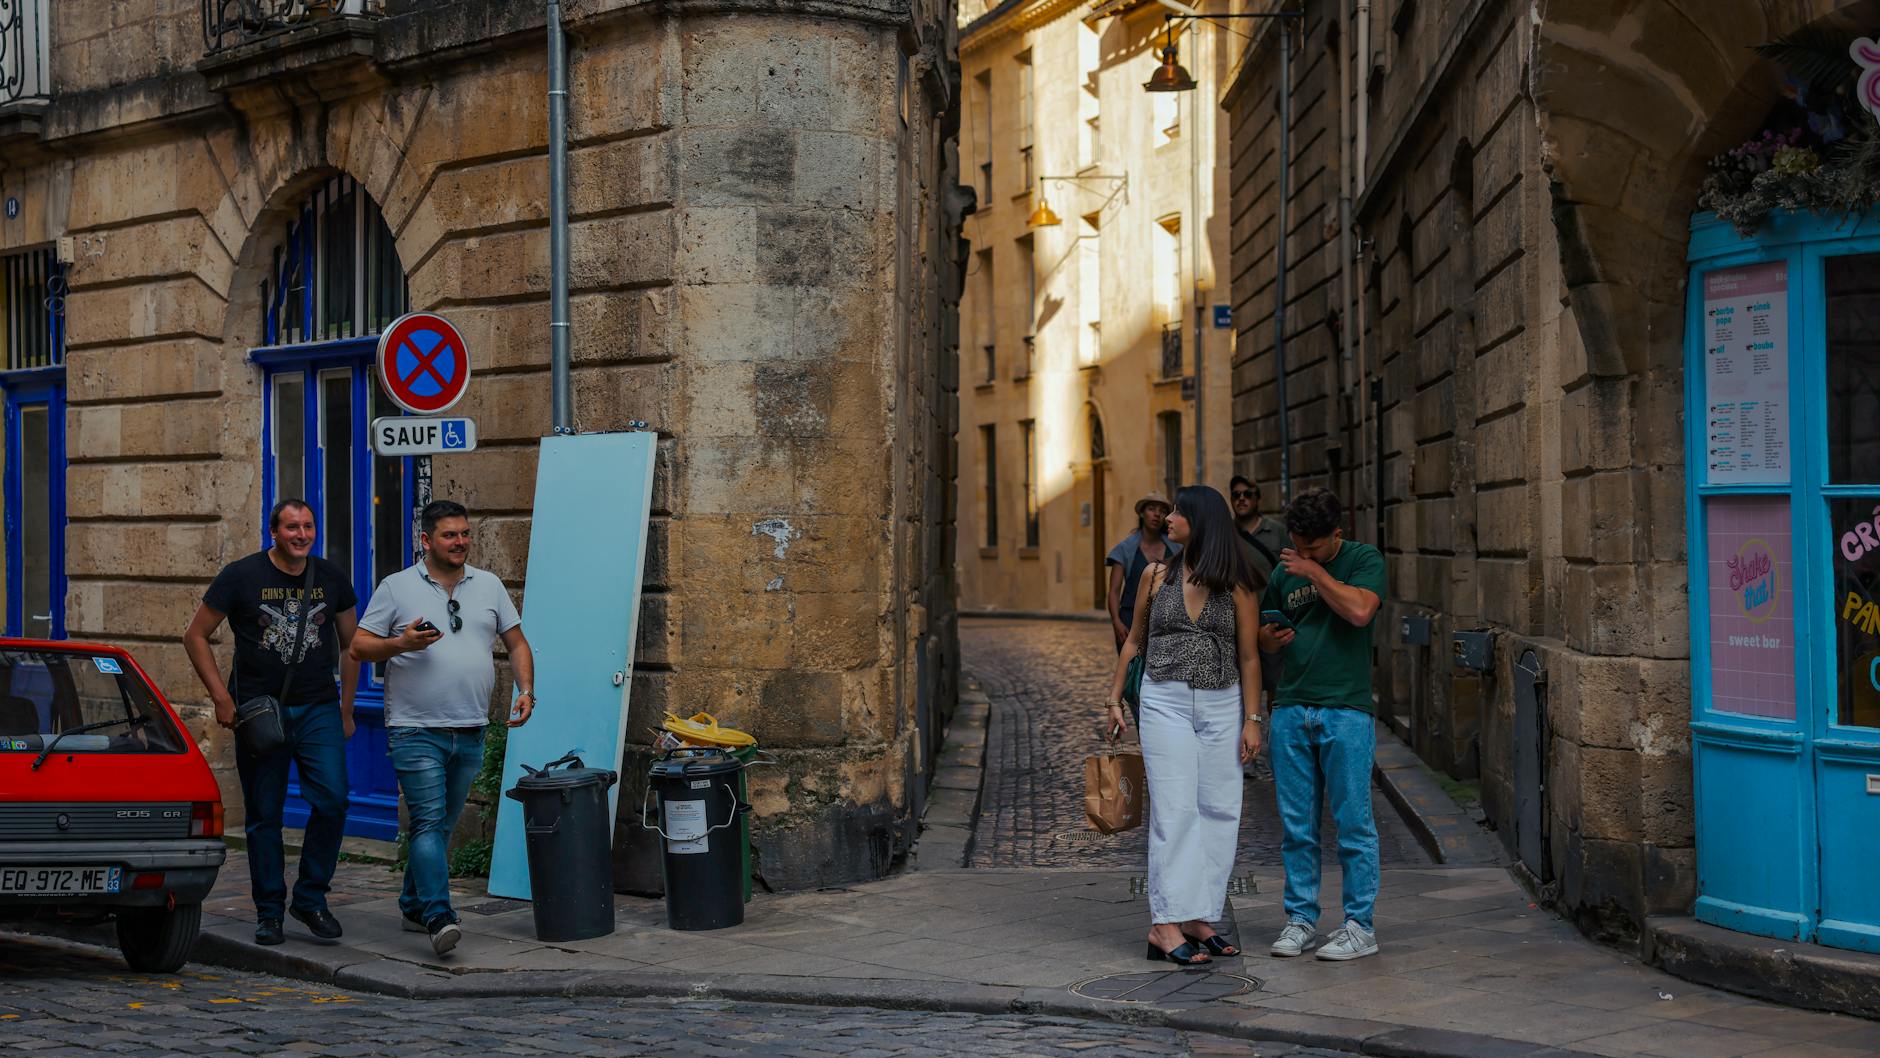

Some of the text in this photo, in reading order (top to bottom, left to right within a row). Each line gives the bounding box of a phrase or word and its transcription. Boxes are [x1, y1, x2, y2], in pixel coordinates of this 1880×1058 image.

[8, 199, 16, 216] 14
[383, 426, 437, 446] SAUF
[1841, 505, 1880, 562] CR
[1727, 553, 1771, 591] Shake
[261, 588, 284, 601] GUNS
[1729, 634, 1781, 650] sweet bar
[107, 880, 119, 890] 33
